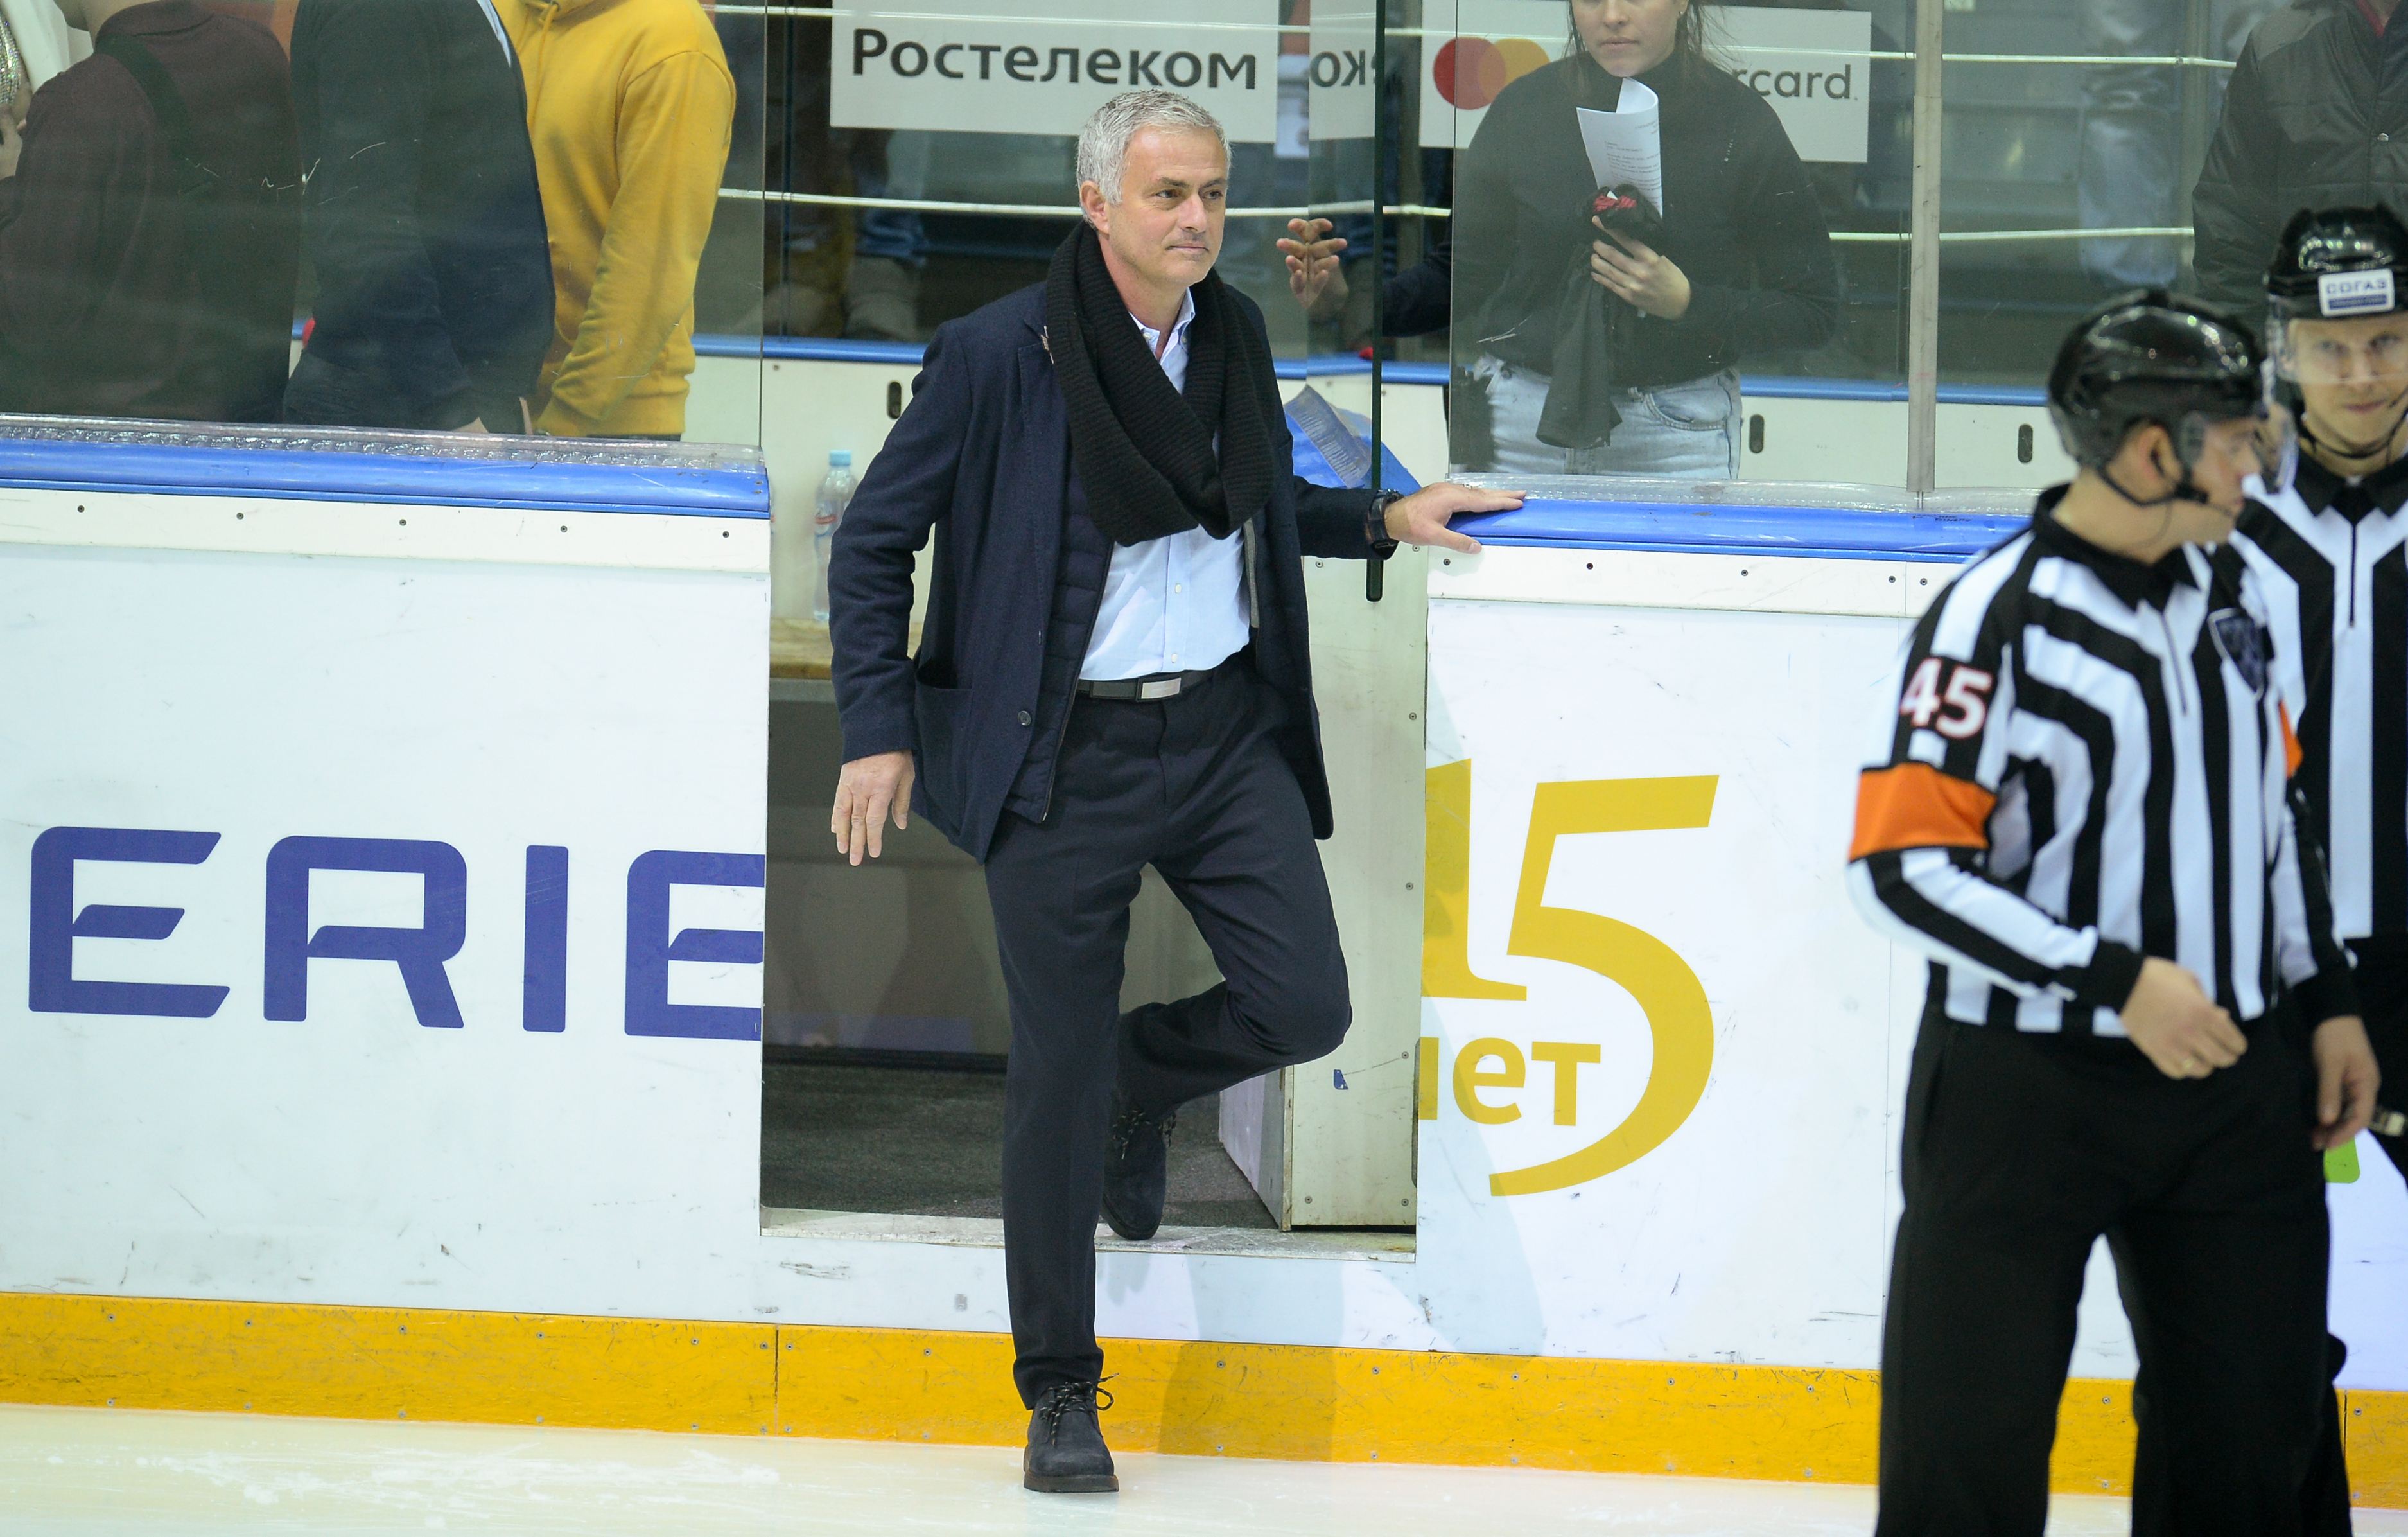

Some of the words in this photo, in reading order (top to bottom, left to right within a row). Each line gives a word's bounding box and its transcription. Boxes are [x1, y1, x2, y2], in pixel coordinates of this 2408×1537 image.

[853, 28, 1257, 90] Ростелеком
[1899, 657, 1993, 739] 45
[28, 825, 765, 1041] ERIE
[1421, 758, 1720, 1197] 15
